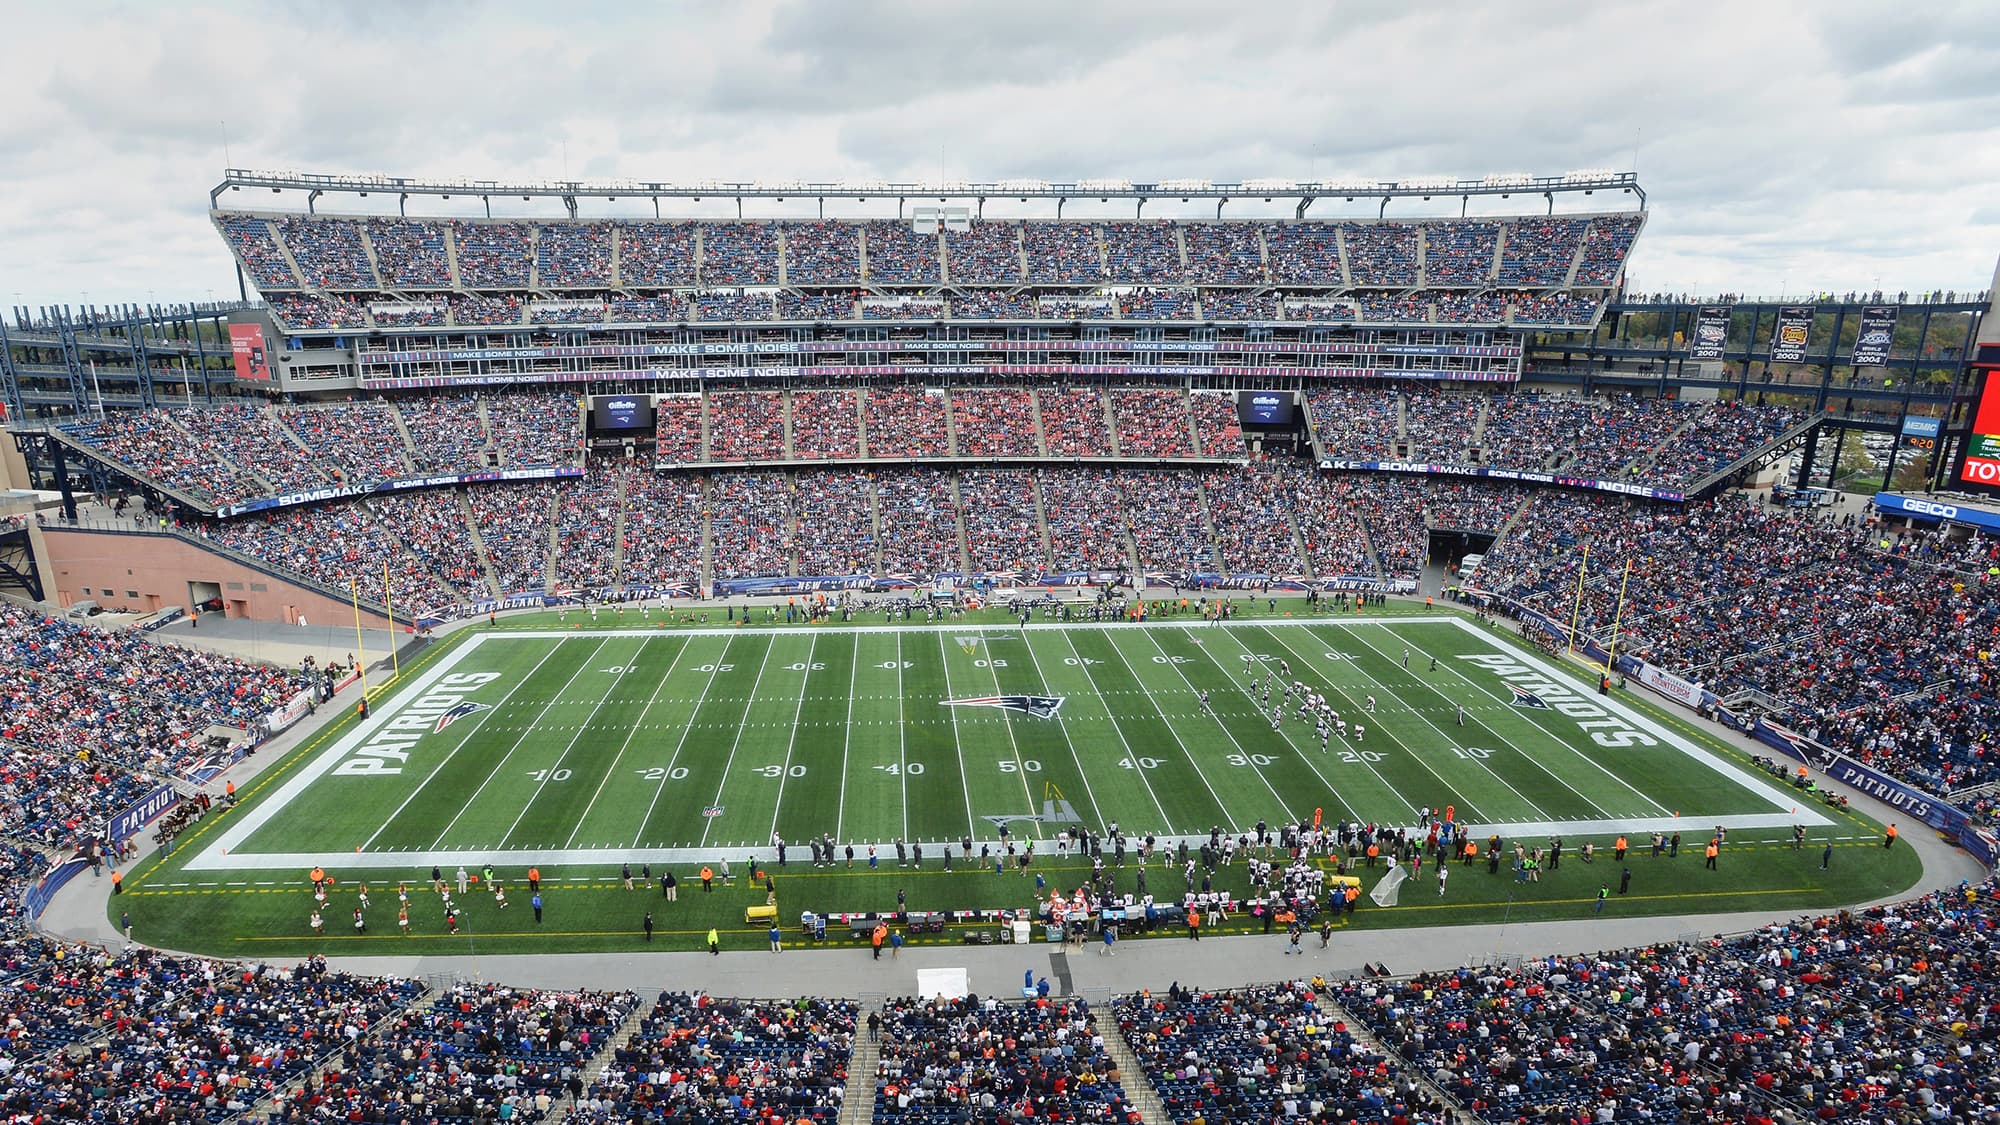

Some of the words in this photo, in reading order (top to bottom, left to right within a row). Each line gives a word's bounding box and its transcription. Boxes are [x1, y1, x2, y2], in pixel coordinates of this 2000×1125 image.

[705, 345, 748, 353] SOME
[754, 344, 798, 352] NOISE
[656, 370, 699, 378] MAKE
[706, 369, 750, 377] SOME
[608, 401, 636, 409] Gillette
[1905, 421, 1937, 432] MEMIC
[1378, 462, 1427, 472] SOME
[503, 469, 556, 479] NOISE
[1440, 467, 1478, 475] MAKE
[1488, 470, 1518, 479] SOME
[1521, 473, 1553, 482] NOISE
[393, 480, 423, 489] SOME
[427, 476, 459, 485] NOISE
[1598, 481, 1653, 497] NOISE
[279, 490, 330, 506] SOME
[1903, 499, 1957, 518] GEICO
[1065, 576, 1088, 585] NEW
[1334, 580, 1357, 590] NEW
[489, 597, 542, 611] ENGLAND
[700, 664, 735, 672] 20
[792, 663, 825, 671] 30
[884, 661, 914, 669] 40
[974, 659, 1008, 667] 50
[1454, 654, 1658, 747] PATRIOTS
[331, 672, 502, 776] PATRIOTS
[1337, 751, 1381, 762] 20
[1450, 748, 1490, 759] 10
[998, 760, 1042, 772] 50
[1118, 757, 1158, 769] 40
[1226, 754, 1271, 766] 30
[533, 769, 572, 781] 10
[644, 767, 689, 779] 20
[763, 765, 807, 777] 30
[885, 763, 925, 775] 40
[1843, 768, 1930, 817] PATRIOTS
